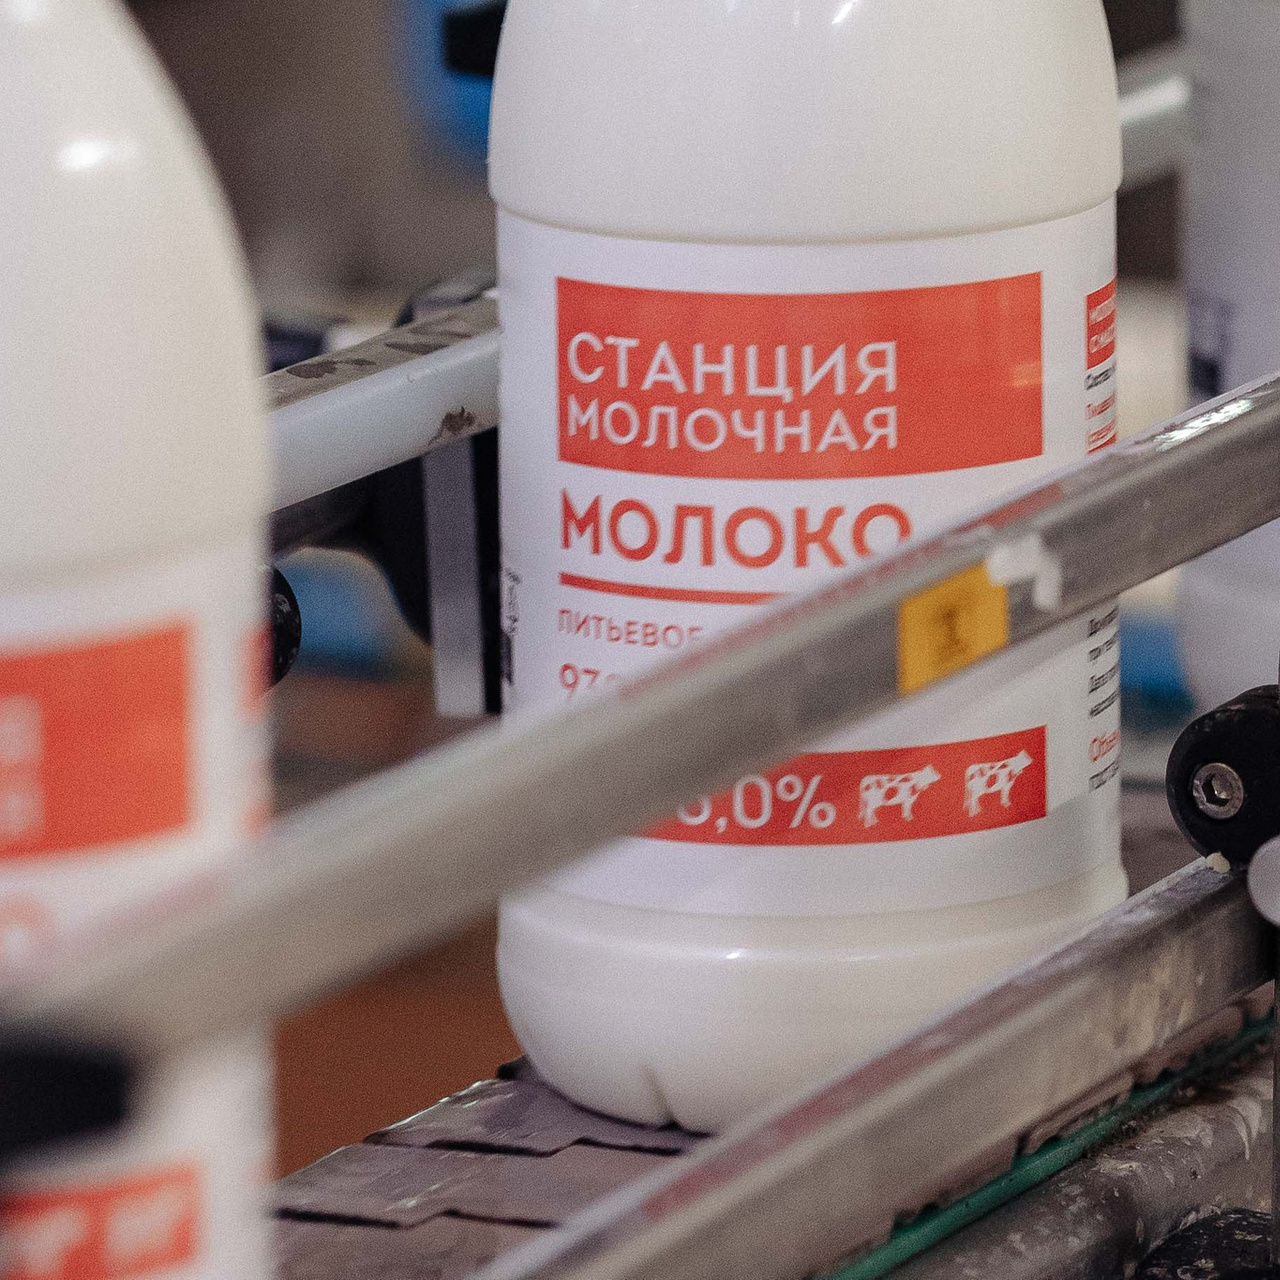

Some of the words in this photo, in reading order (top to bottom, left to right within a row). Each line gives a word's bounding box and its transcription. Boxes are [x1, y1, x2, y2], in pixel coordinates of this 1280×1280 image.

[568, 332, 897, 403] СТАНЦИЯ
[568, 394, 897, 453] МОЛОЧНАЯ
[561, 488, 911, 567] МОЛОКО
